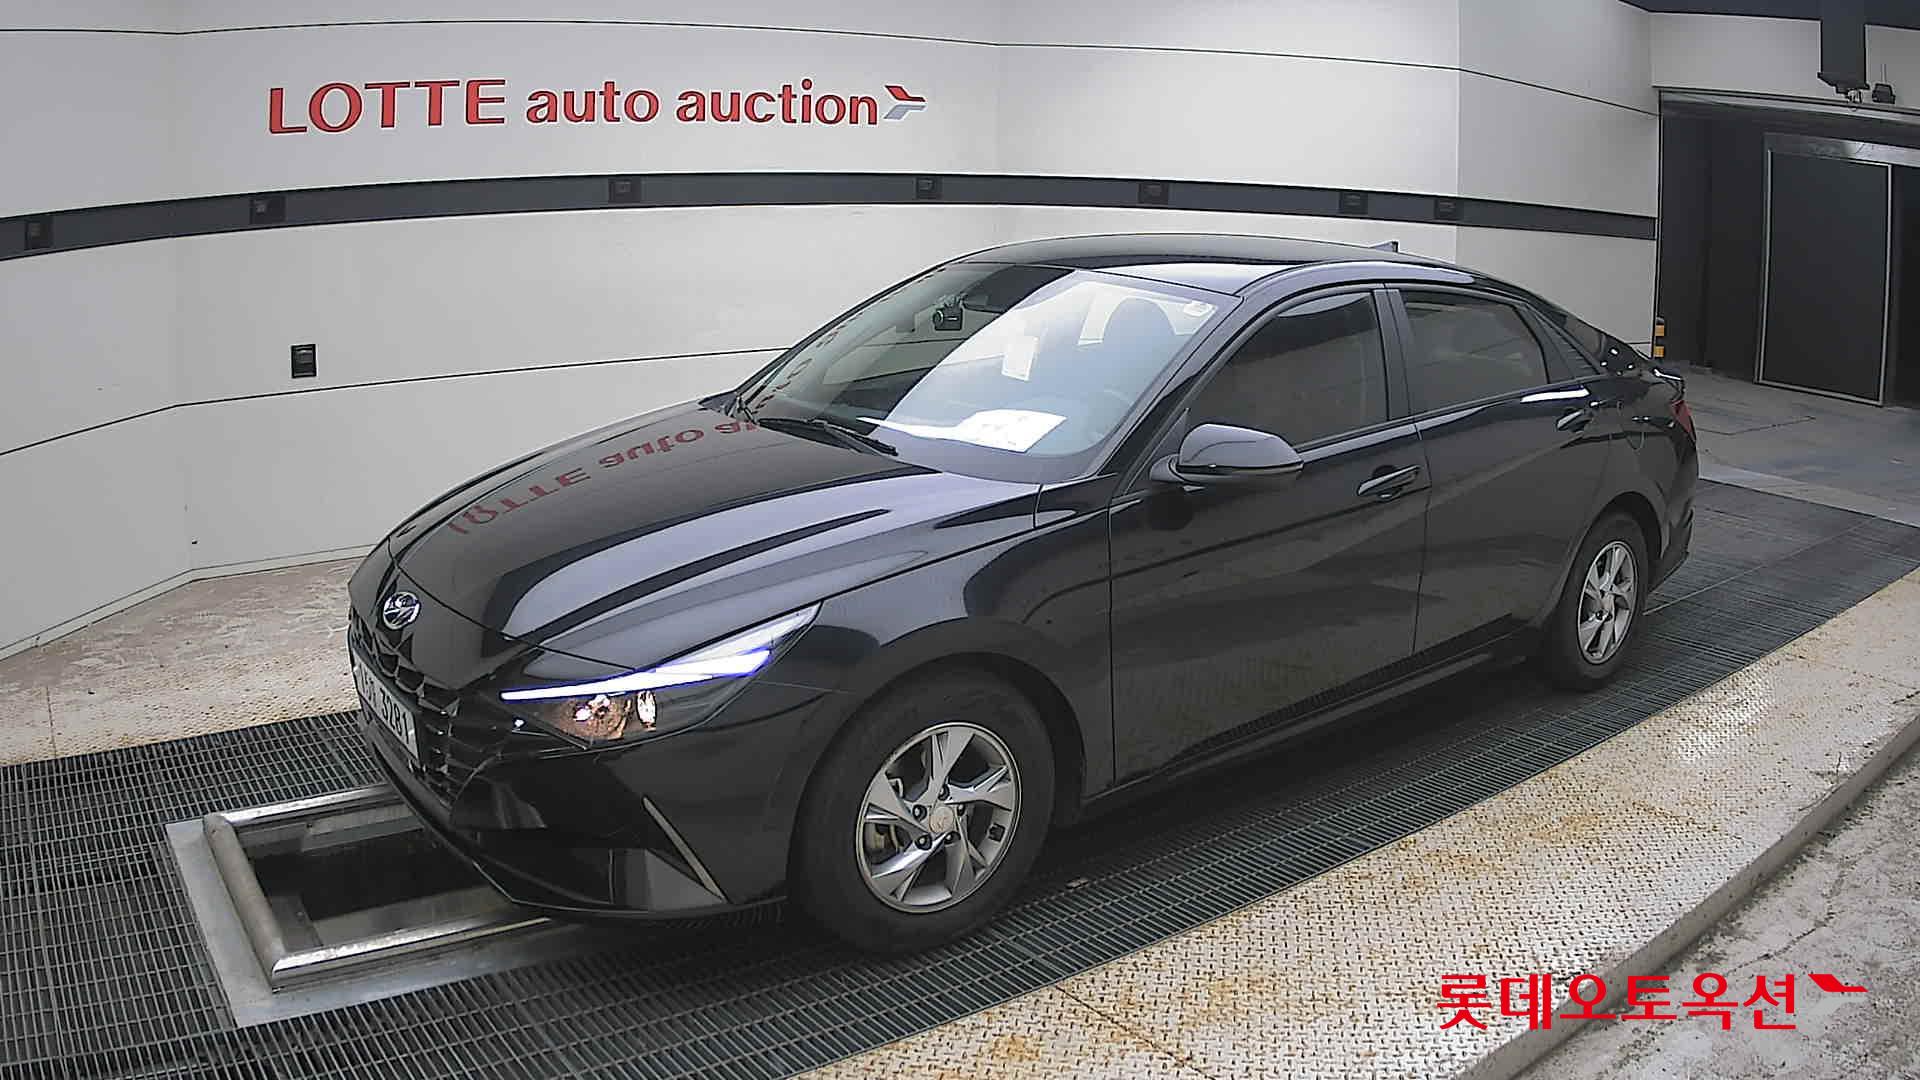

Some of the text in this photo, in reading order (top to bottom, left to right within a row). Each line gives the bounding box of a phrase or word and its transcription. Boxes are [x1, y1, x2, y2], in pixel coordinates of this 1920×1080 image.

[268, 78, 878, 134] LOTTE auto auction
[379, 686, 410, 745] 3281
